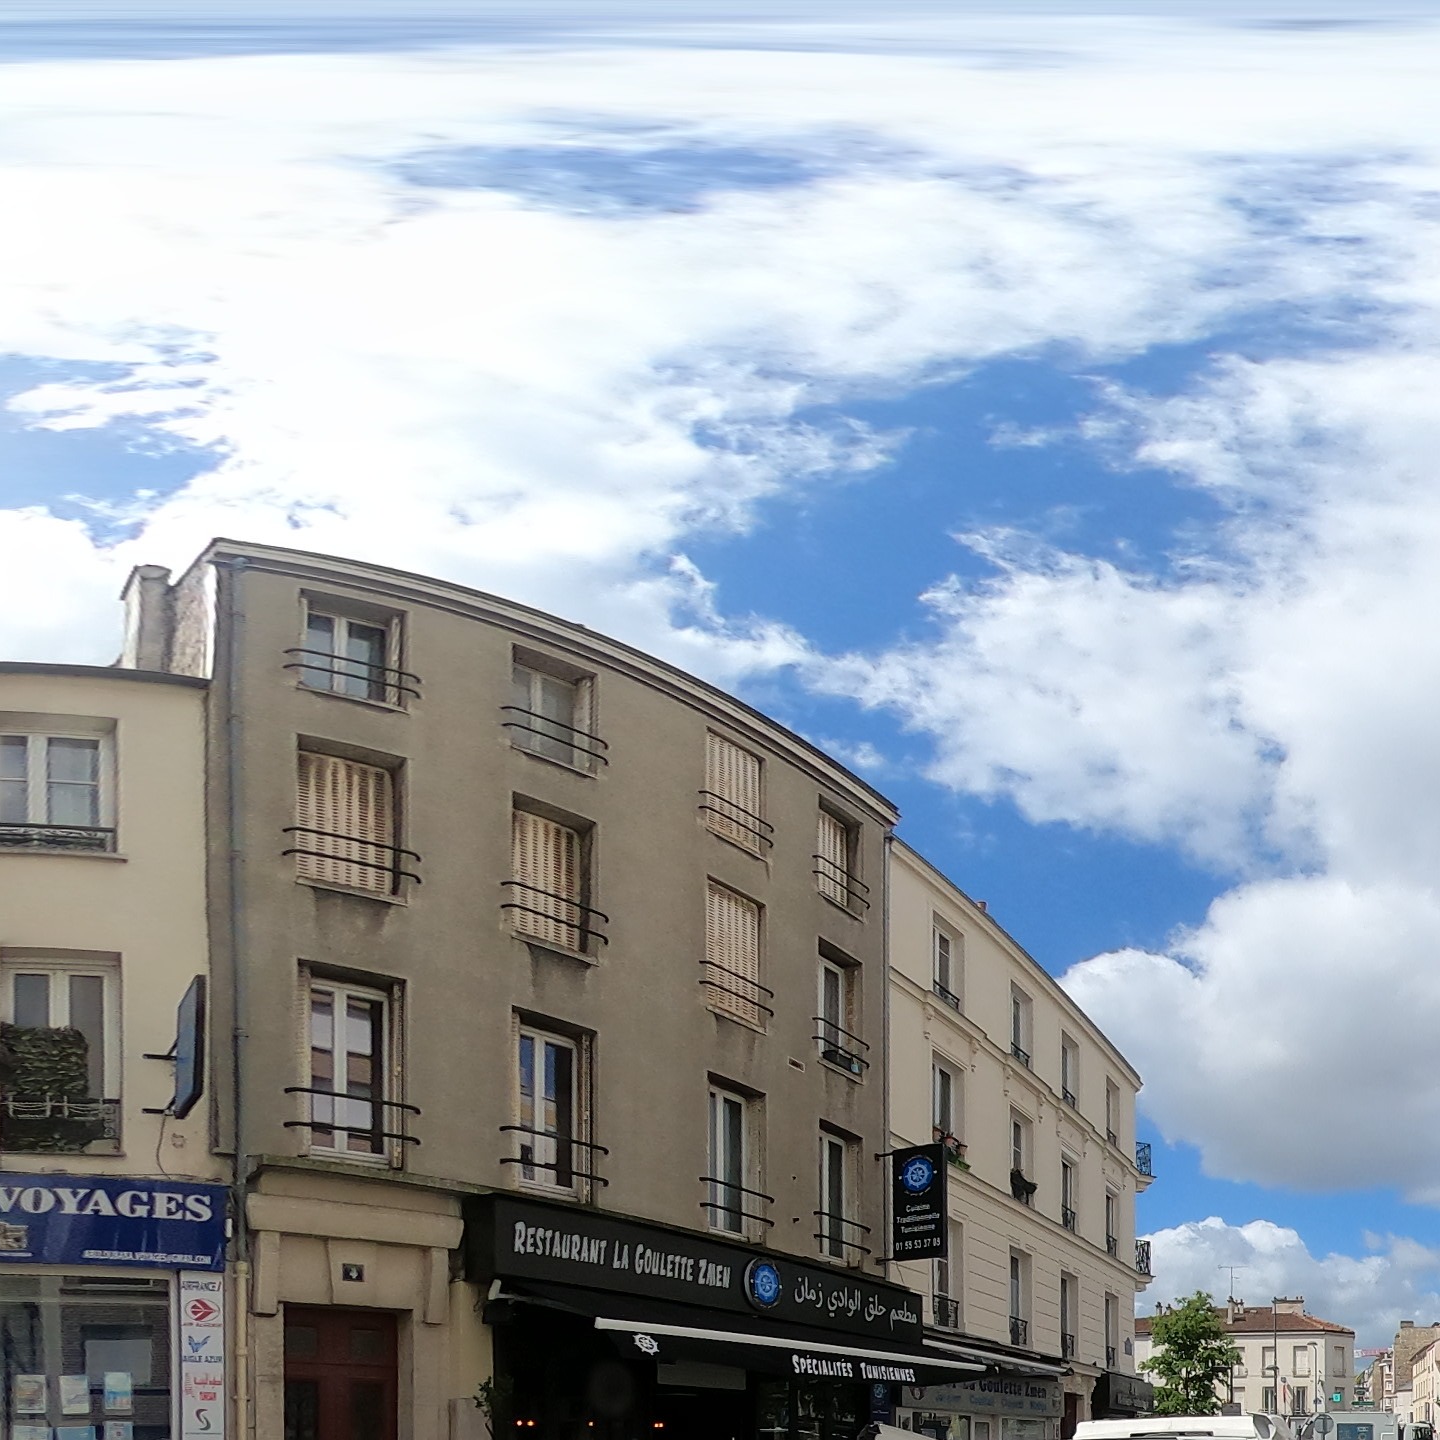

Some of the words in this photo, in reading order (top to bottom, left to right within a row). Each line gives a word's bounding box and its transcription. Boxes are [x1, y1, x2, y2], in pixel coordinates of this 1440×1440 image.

[895, 1242, 903, 1251] 01
[794, 1276, 823, 1308] زمان
[827, 1286, 861, 1318] الوادي
[864, 1293, 887, 1322] حلق
[889, 1300, 918, 1332] مطعم
[204, 1355, 223, 1363] AZUR
[791, 1354, 853, 1378] SPÉCIALITÉS
